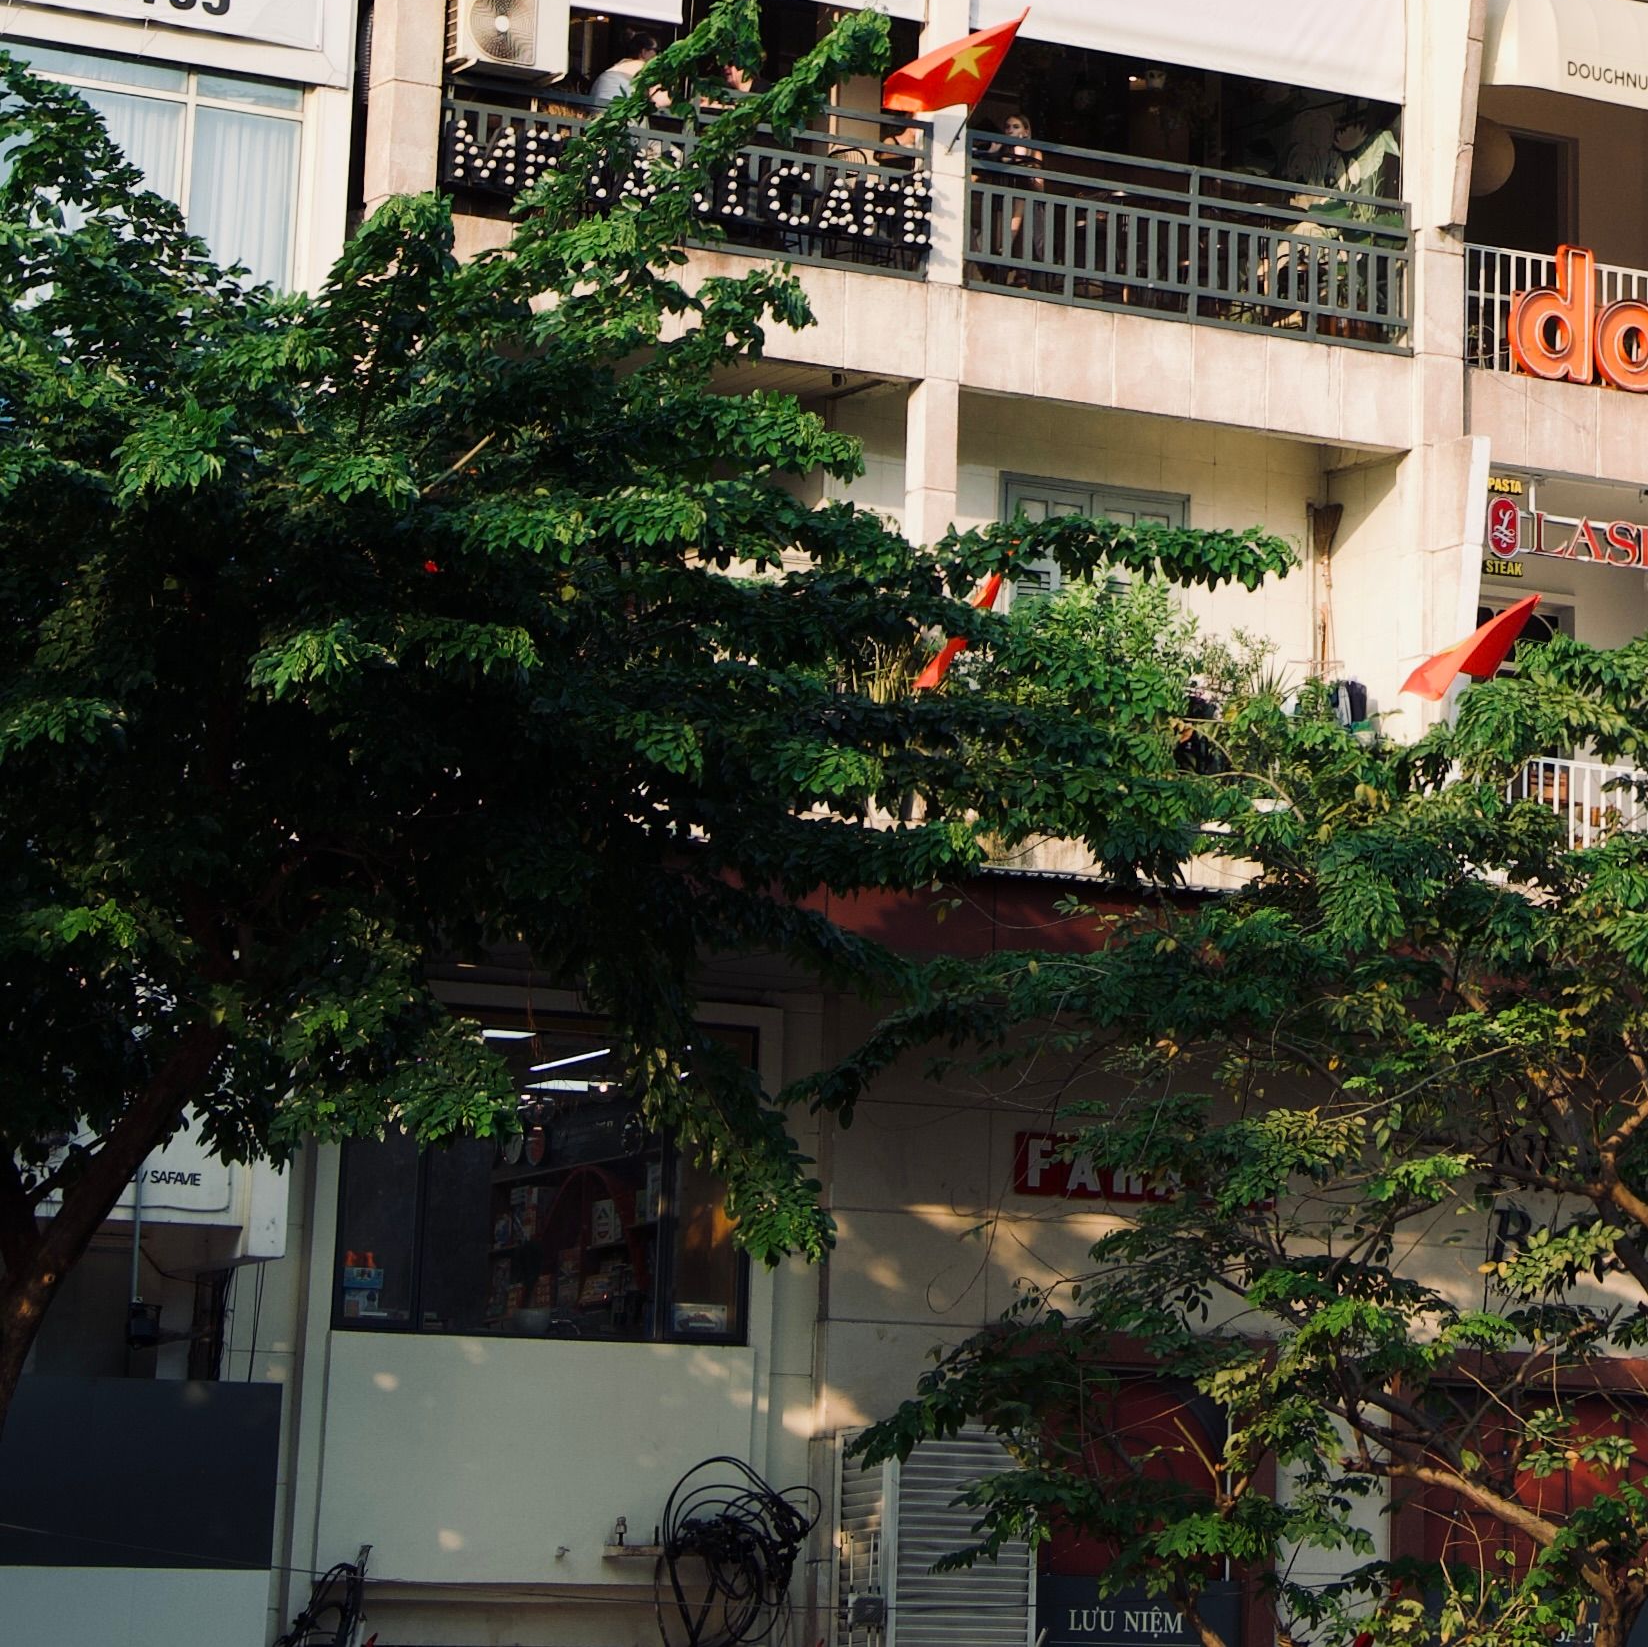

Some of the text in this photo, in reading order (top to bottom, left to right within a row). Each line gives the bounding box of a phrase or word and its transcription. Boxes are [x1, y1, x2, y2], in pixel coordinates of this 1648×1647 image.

[1488, 478, 1523, 494] PASTA
[1485, 560, 1523, 577] STEAK
[150, 1170, 202, 1186] SAFAVIE
[1068, 1604, 1184, 1636] LƯU NIỆM
